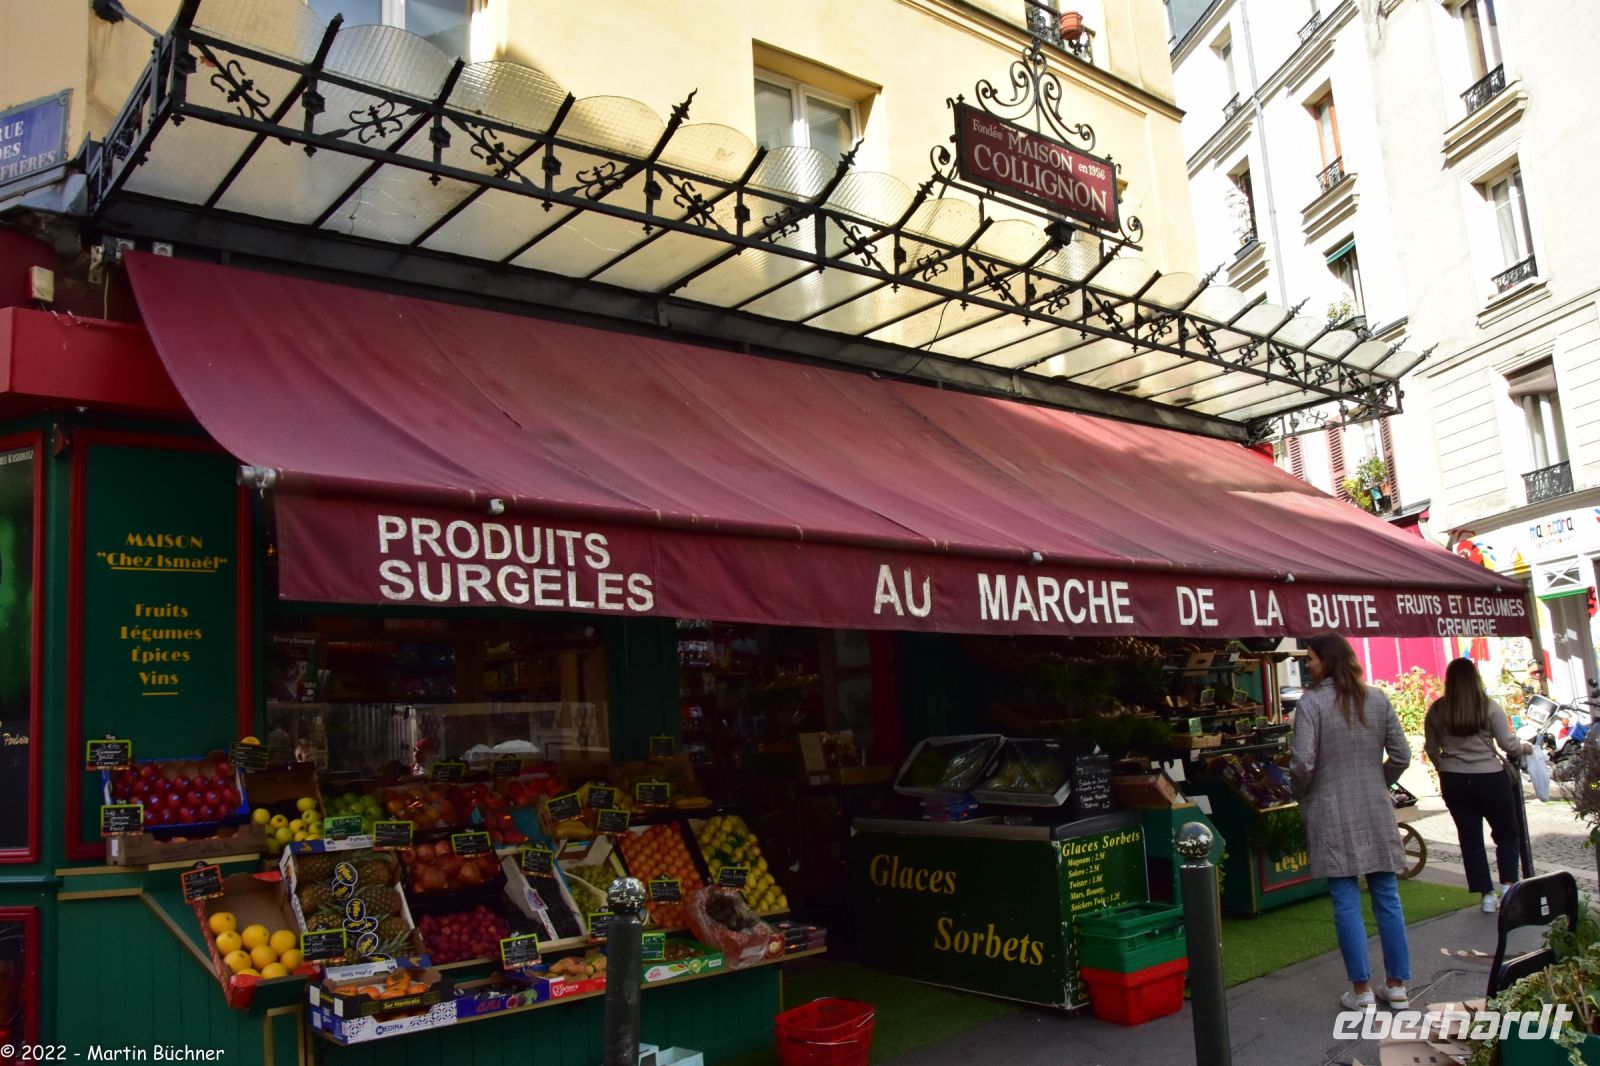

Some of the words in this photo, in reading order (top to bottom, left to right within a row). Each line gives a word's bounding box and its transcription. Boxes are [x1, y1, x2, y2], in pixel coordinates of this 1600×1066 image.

[972, 118, 1003, 140] Fondée
[1008, 132, 1073, 173] MAISON
[1078, 163, 1088, 175] en
[0, 150, 56, 181] FRÈRES
[974, 143, 1107, 214] COLLIGNON
[125, 533, 203, 549] MAISON
[377, 514, 611, 569] PRODUITS
[378, 559, 654, 612] SURGELES
[873, 564, 932, 618] AU
[977, 573, 1134, 624] MARCHE
[1176, 586, 1219, 627] DE
[1249, 589, 1285, 626] LA
[1306, 593, 1380, 628] BUTTE
[135, 604, 189, 618] Fruits
[1396, 594, 1443, 616] FRUITS
[1447, 594, 1463, 615] ET
[1466, 596, 1525, 617] LEGUMES
[120, 625, 203, 642] Légumes
[1437, 617, 1497, 637] CREMERIE
[131, 645, 190, 664] Épices
[139, 671, 179, 686] Vins
[1062, 840, 1099, 857] Glaces
[1102, 831, 1141, 849] Sorbets
[869, 854, 957, 894] Glaces
[933, 916, 1045, 966] Sorbets
